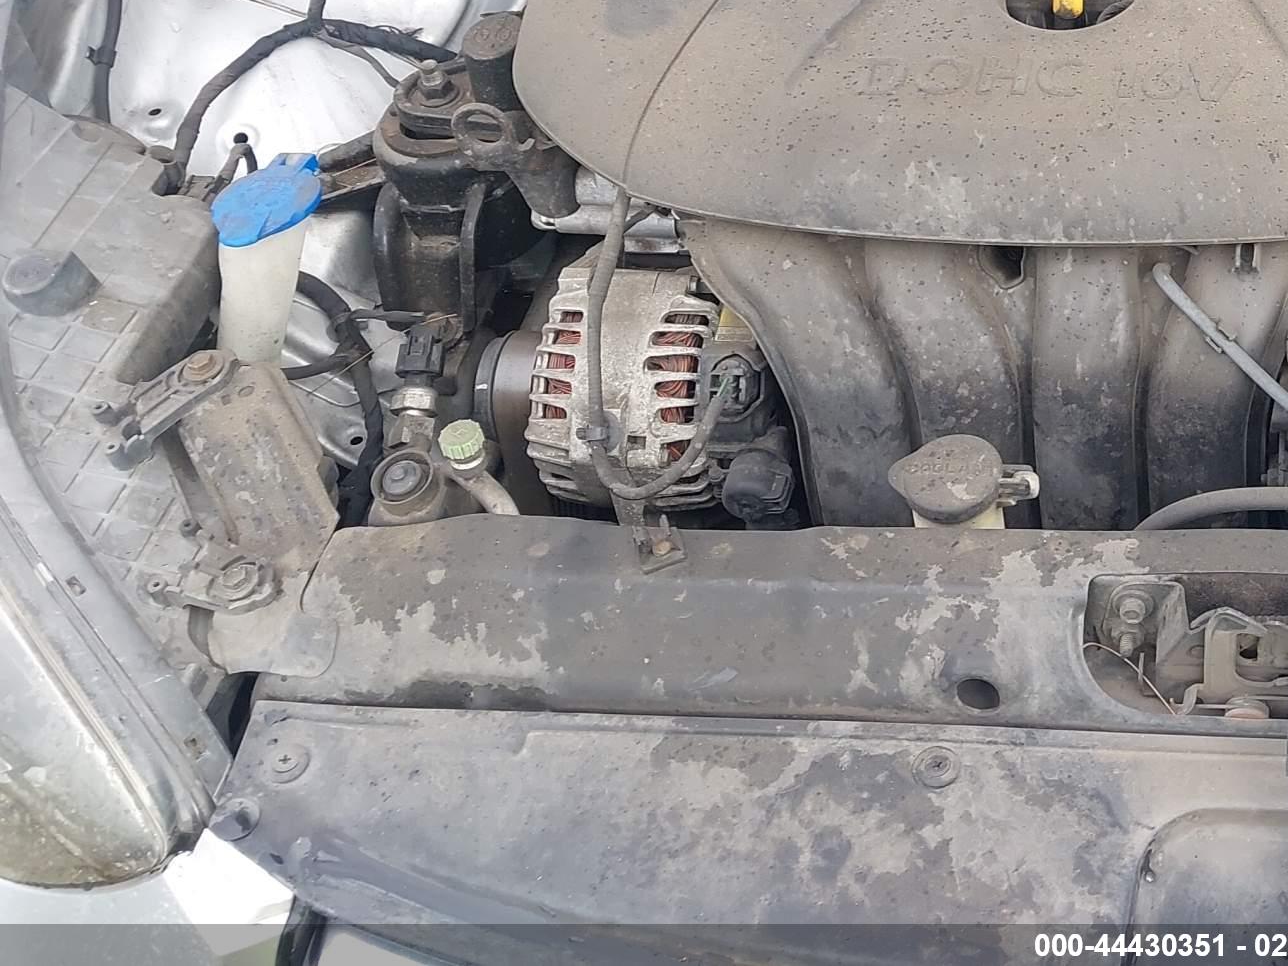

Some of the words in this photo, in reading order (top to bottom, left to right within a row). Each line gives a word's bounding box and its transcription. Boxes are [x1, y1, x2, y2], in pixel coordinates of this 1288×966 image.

[851, 56, 1084, 98] DOHC
[1111, 61, 1243, 102] 16V
[904, 463, 983, 475] COOLA
